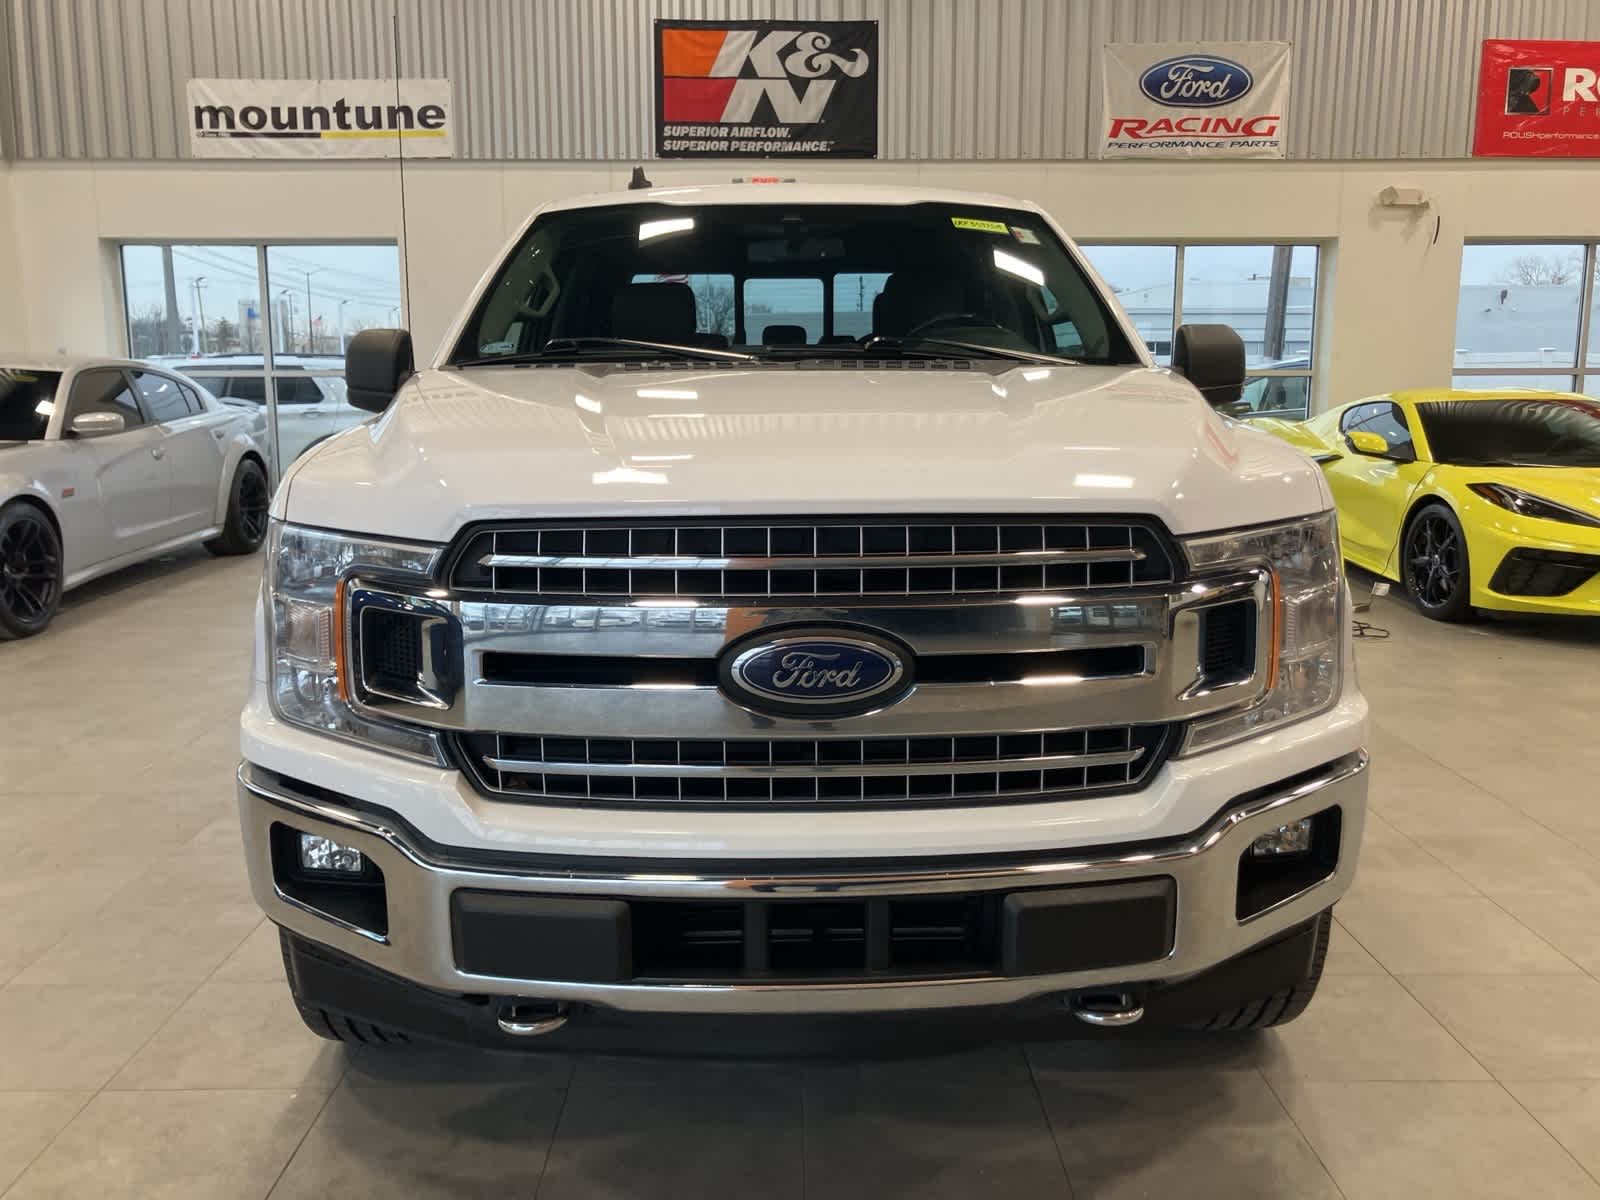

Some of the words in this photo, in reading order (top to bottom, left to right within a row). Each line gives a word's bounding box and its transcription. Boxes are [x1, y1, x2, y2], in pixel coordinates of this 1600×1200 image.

[1160, 63, 1232, 99] Ford
[1562, 67, 1600, 102] R
[194, 97, 446, 131] mountune
[1108, 116, 1281, 139] RACING
[663, 125, 728, 137] SUPERIOR
[730, 126, 792, 138] AIRFLOW.
[663, 139, 728, 151] SUPERIOR
[1107, 140, 1225, 149] PERFORMANCE
[1229, 140, 1280, 148] PARTS
[772, 651, 864, 688] Ford
